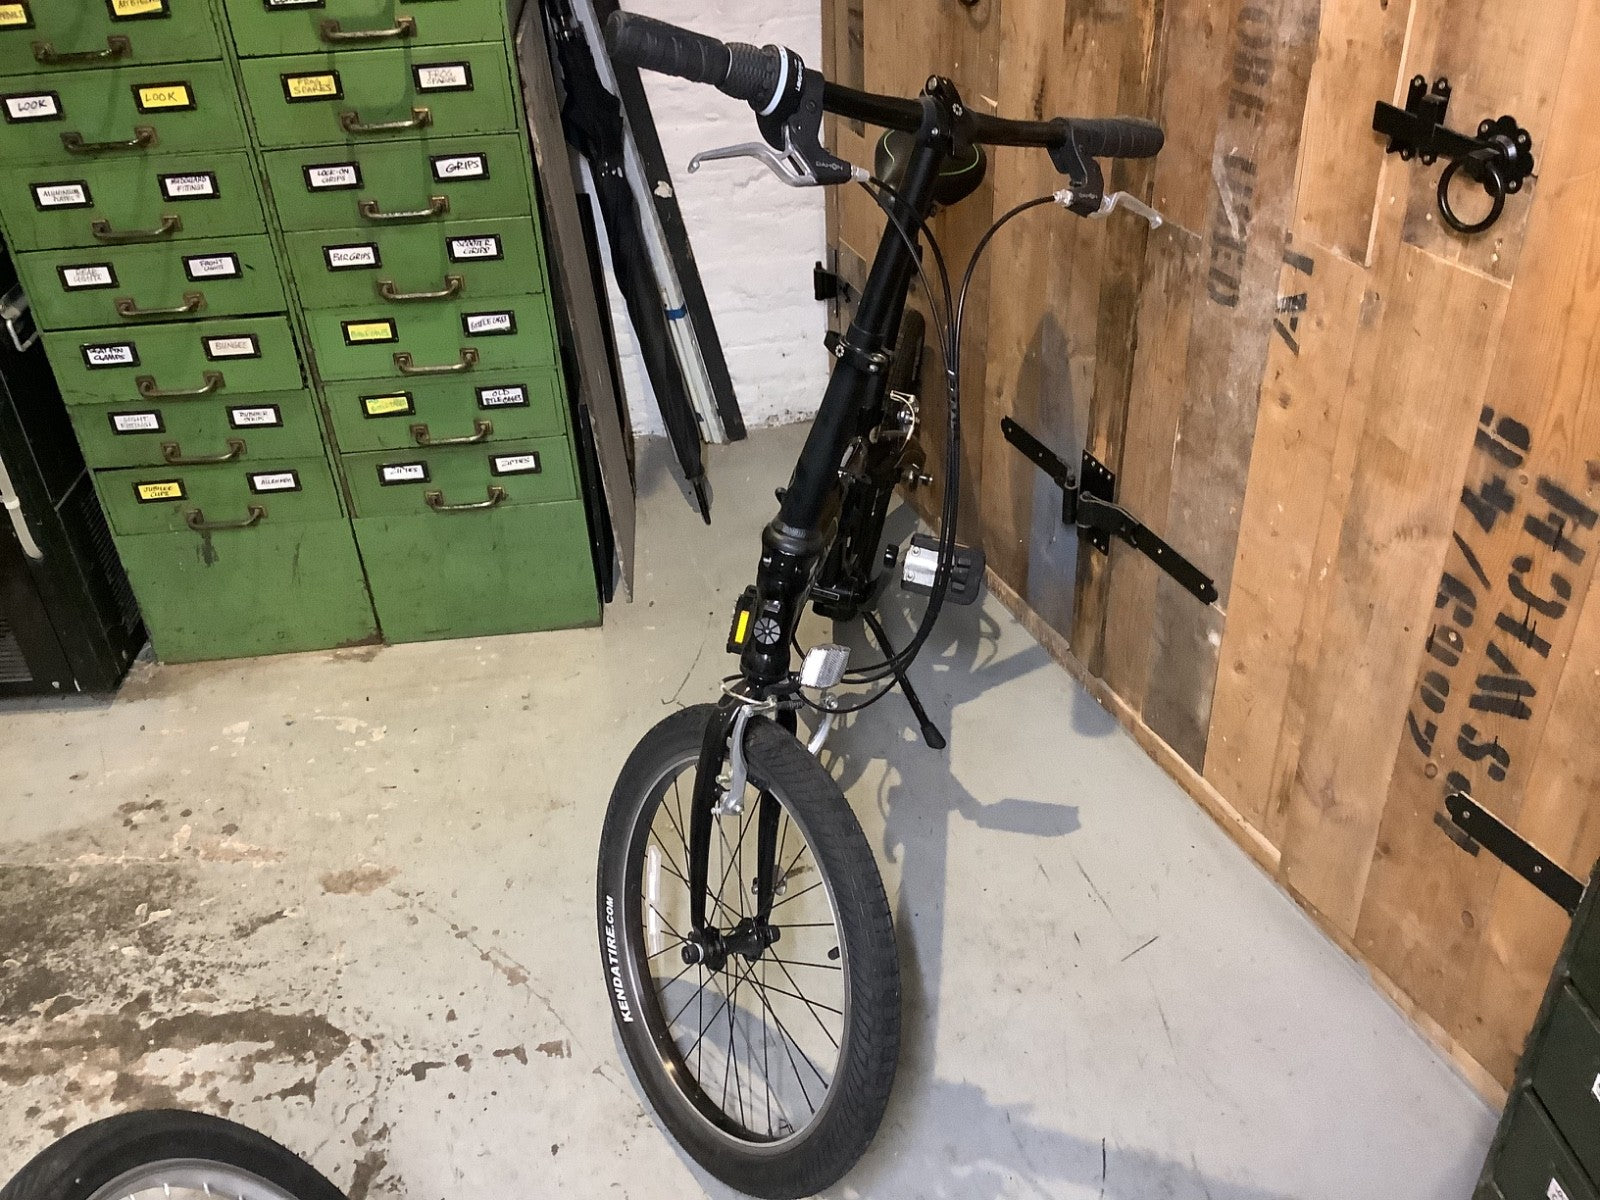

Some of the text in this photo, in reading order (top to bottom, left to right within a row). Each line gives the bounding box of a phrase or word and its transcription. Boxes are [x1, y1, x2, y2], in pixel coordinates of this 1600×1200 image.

[293, 84, 333, 95] SPARES
[144, 90, 178, 103] LOOK
[17, 99, 48, 112] LOOK
[445, 159, 480, 174] GRIPS
[320, 175, 347, 184] GRIPS
[462, 246, 491, 255] GRIPS
[198, 259, 224, 268] FRONT
[214, 340, 248, 350] BUNGEE
[93, 353, 126, 362] CLAMPS
[491, 389, 510, 397] OLD
[143, 485, 173, 493] JUBILEE
[605, 894, 634, 1023] KENDATIRE.COM
